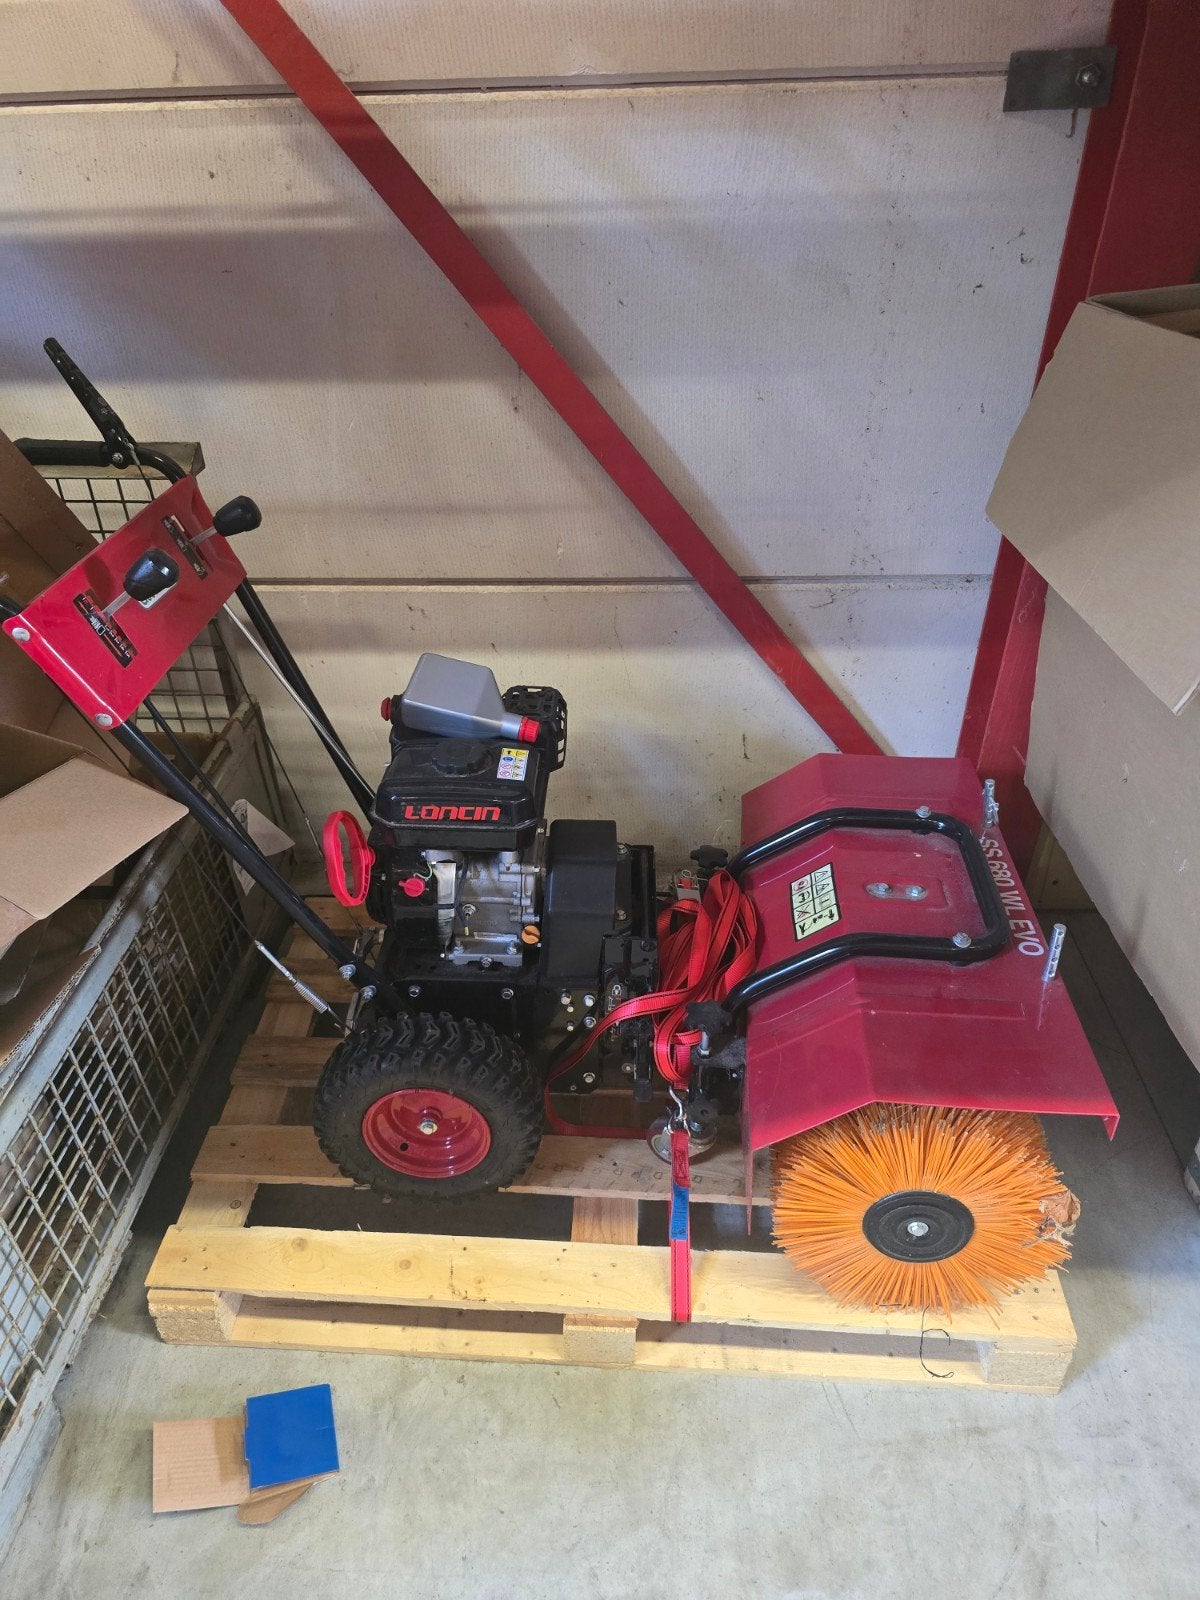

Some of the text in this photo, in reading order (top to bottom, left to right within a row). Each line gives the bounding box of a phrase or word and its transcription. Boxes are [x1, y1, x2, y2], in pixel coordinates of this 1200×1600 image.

[982, 838, 1045, 956] SS 680 WL EVO
